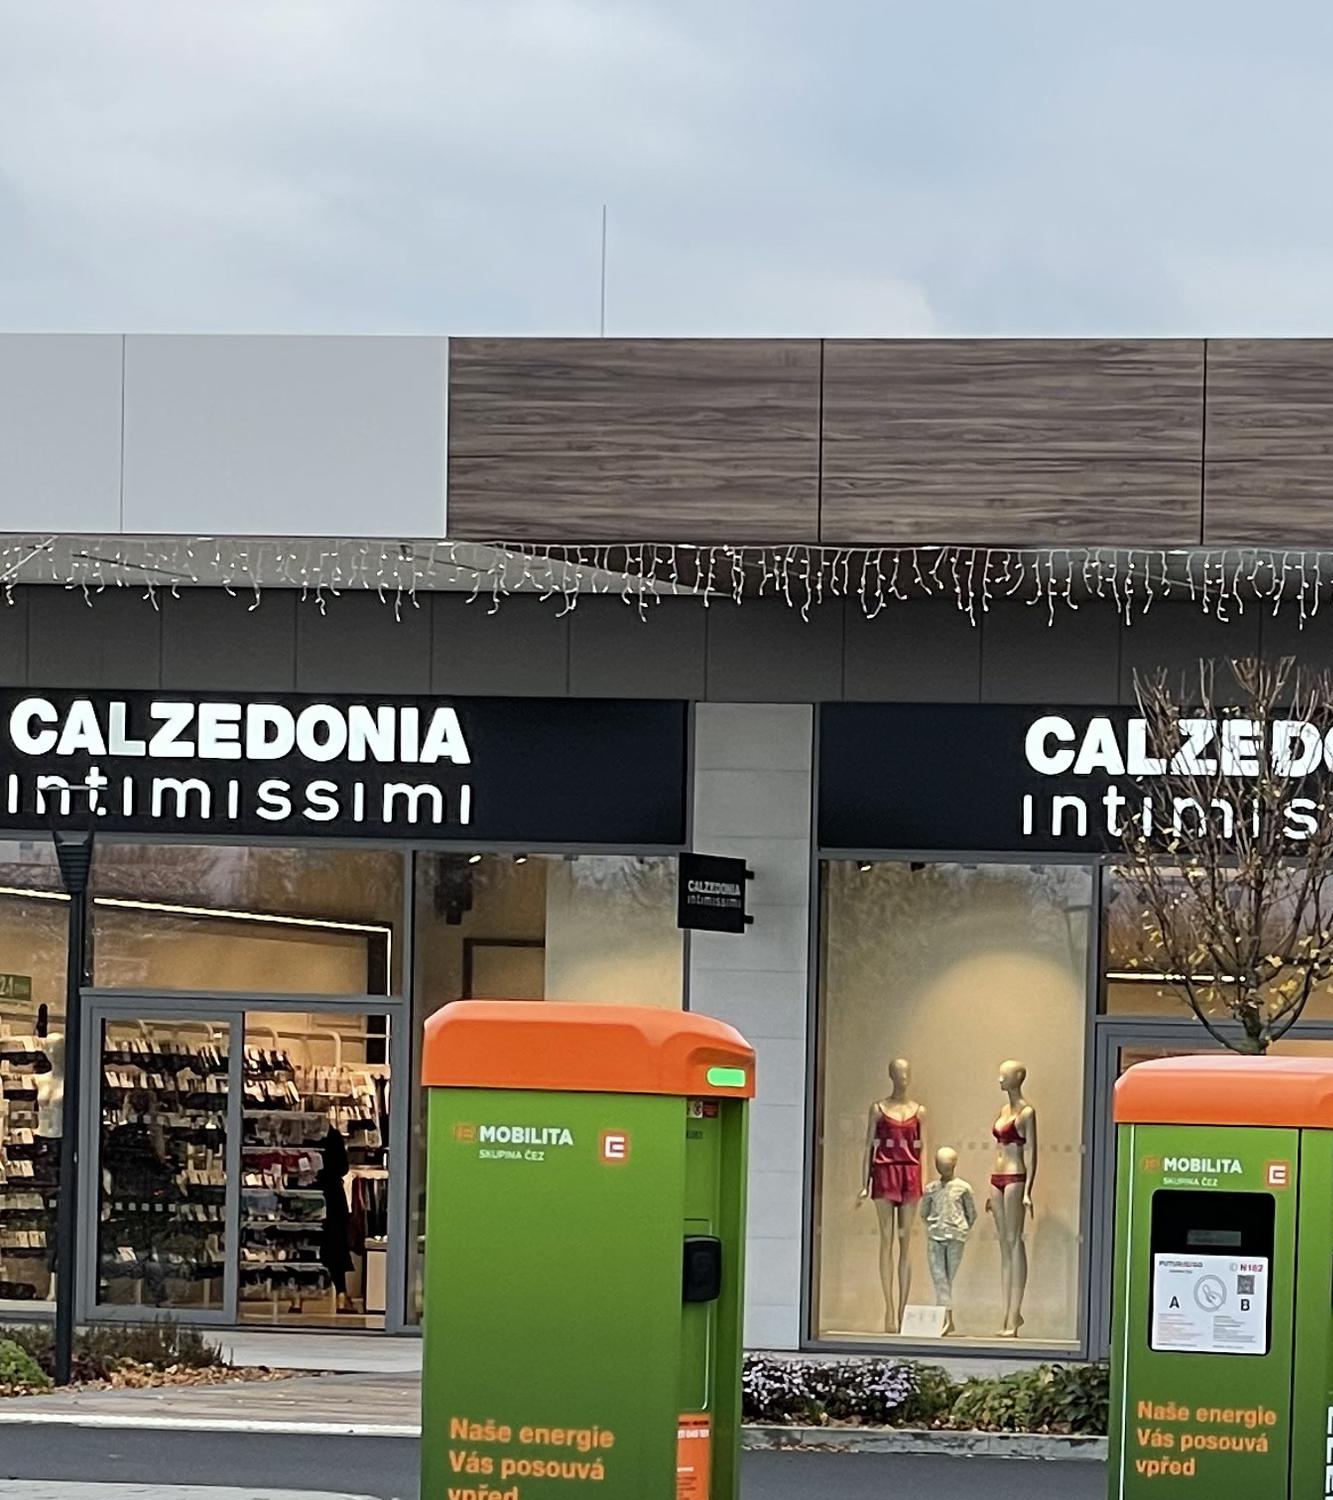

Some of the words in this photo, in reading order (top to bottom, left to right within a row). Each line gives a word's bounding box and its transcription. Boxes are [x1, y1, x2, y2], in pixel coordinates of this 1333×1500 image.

[9, 698, 471, 764] CALZEDONIA
[8, 766, 470, 824] intimissimi
[479, 1149, 522, 1160] SKUPINA
[525, 1148, 545, 1161] ČEZ
[1169, 1295, 1180, 1309] A
[1241, 1299, 1250, 1311] B
[1138, 1401, 1189, 1421] Naše
[1196, 1406, 1277, 1428] energie
[450, 1418, 511, 1443] Naše
[520, 1425, 615, 1451] energie
[1137, 1428, 1174, 1448] Vás
[1181, 1433, 1268, 1452] posouvá
[449, 1450, 493, 1474] Vás
[501, 1457, 605, 1481] posouvá
[1136, 1456, 1196, 1478] vpřed
